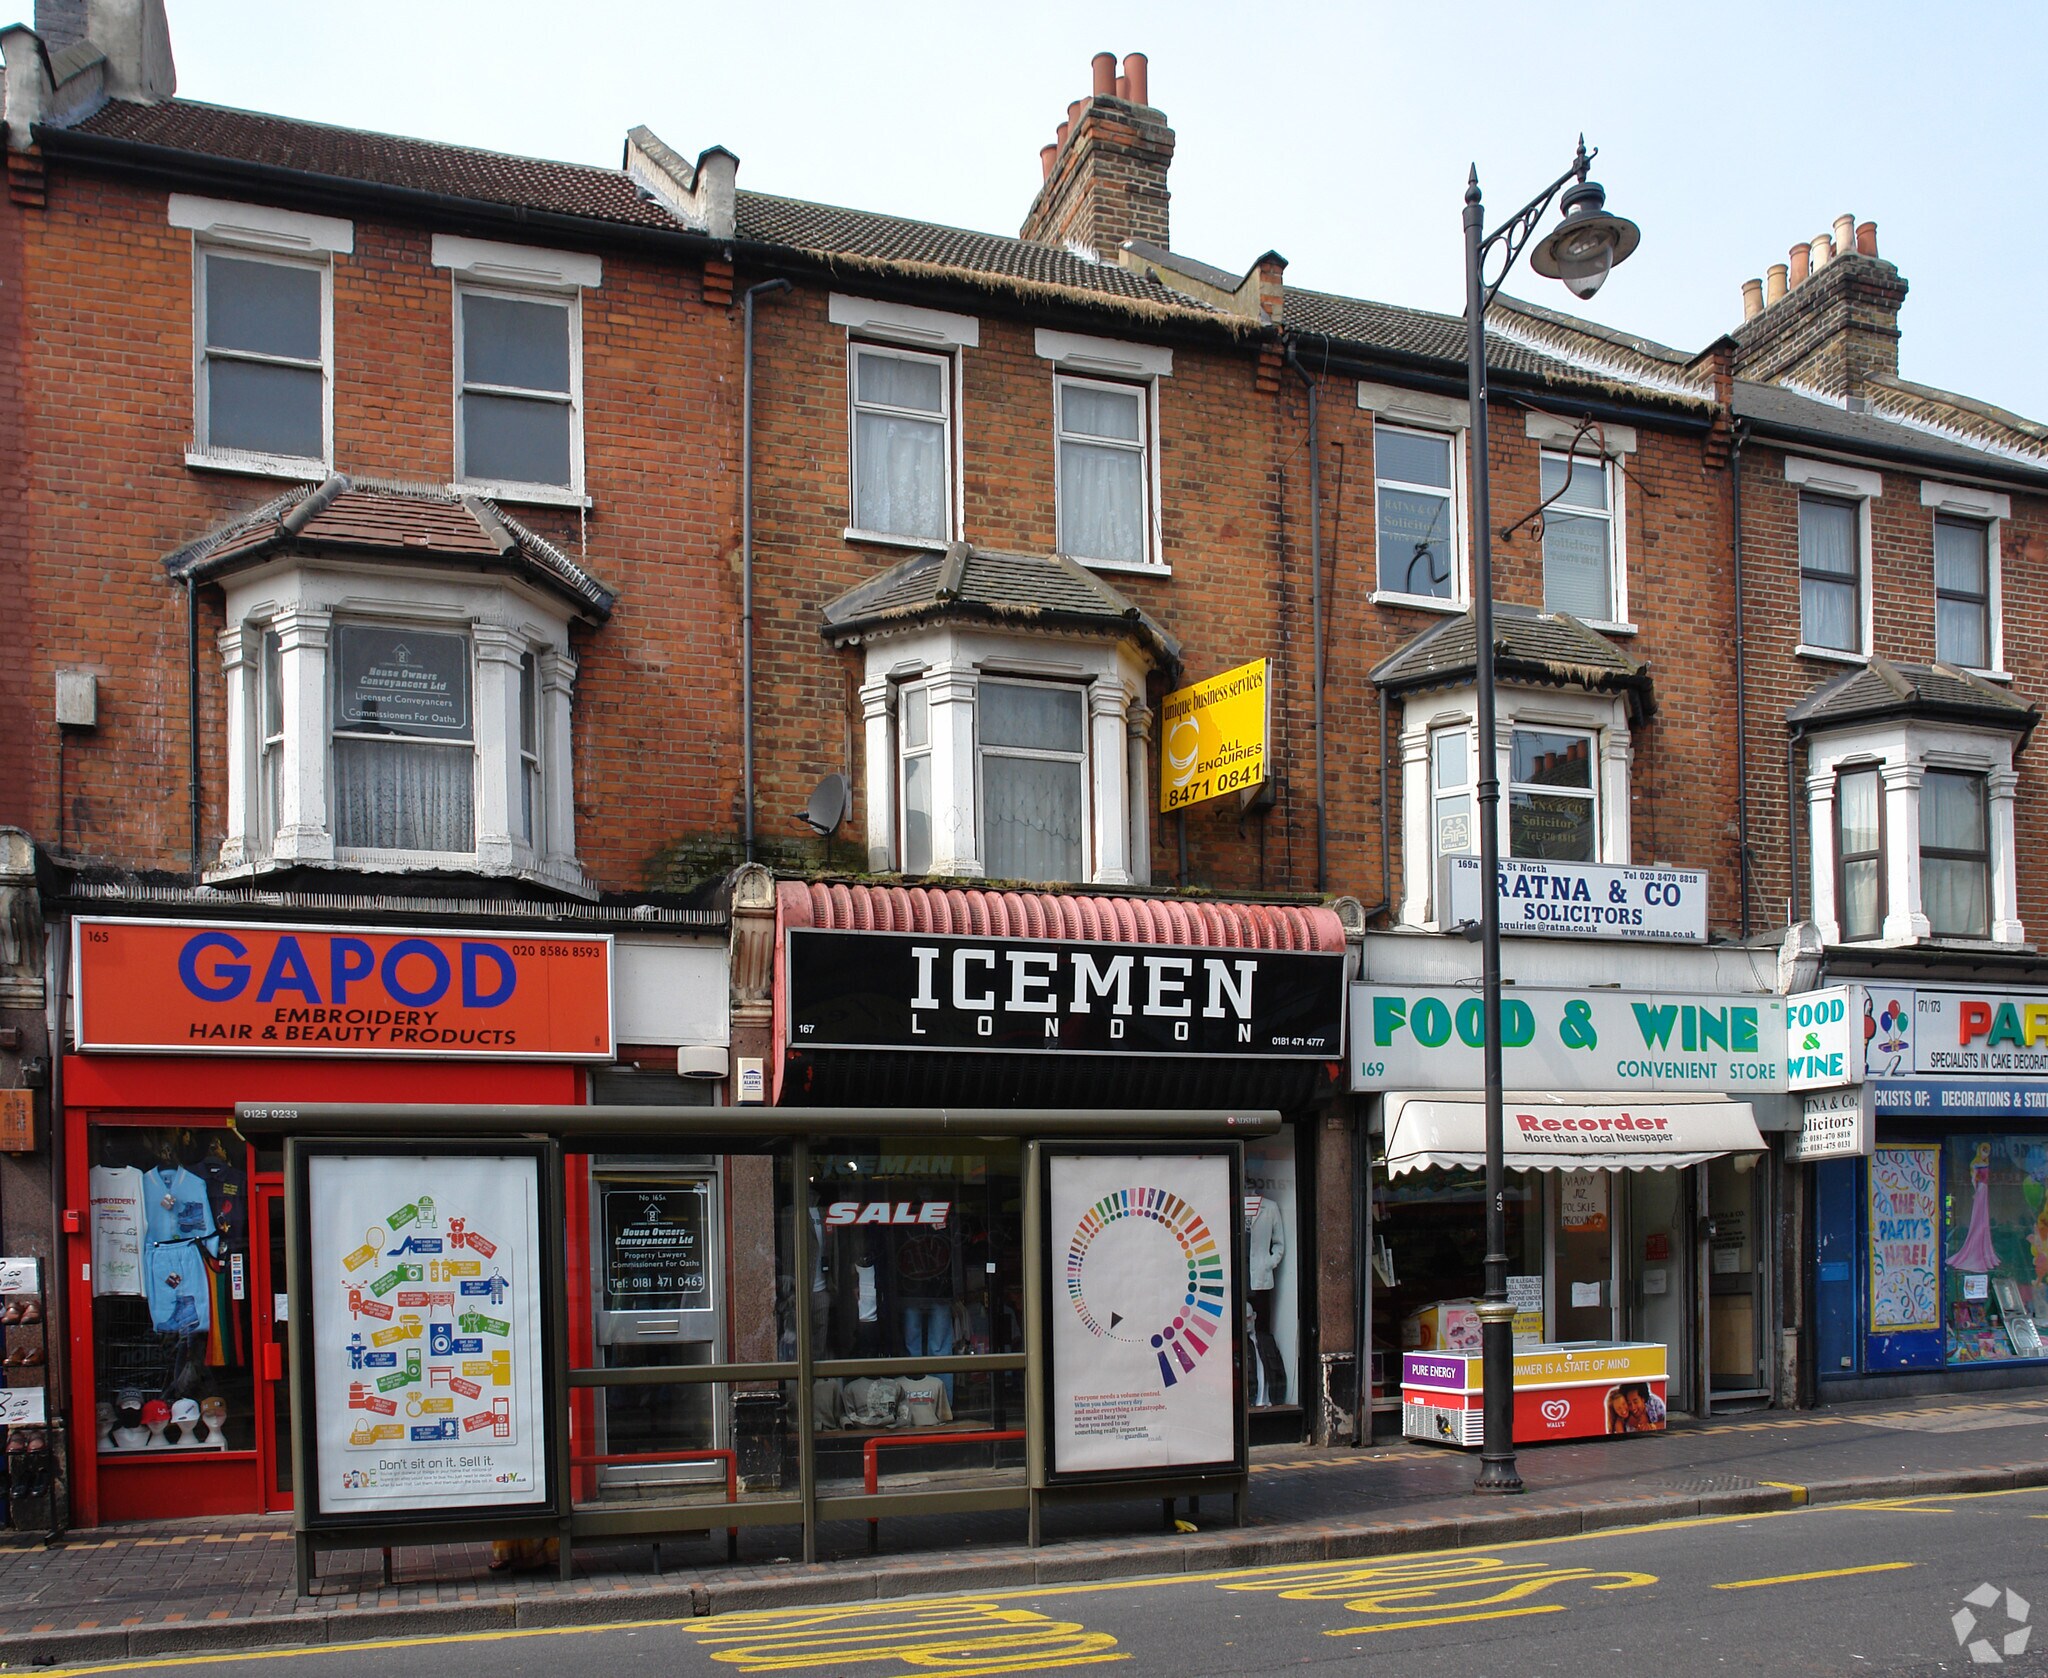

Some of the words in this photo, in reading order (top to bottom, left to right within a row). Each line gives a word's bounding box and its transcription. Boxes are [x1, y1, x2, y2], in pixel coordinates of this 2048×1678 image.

[369, 667, 399, 677] House
[402, 669, 437, 680] Owners
[360, 676, 428, 690] Conveyancers
[430, 681, 447, 691] Ltd
[355, 692, 392, 703] Licensed
[394, 695, 453, 707] Conveyancers
[1164, 697, 1192, 722] unique
[1193, 684, 1228, 710] business
[1229, 670, 1263, 699] services
[349, 708, 412, 720] Commissioners
[414, 713, 428, 721] For
[431, 714, 457, 723] Oaths
[1218, 739, 1243, 755] ALL
[1197, 743, 1263, 774] ENQUIRIES
[1169, 779, 1210, 807] 8471
[1217, 762, 1261, 792] 0841
[1522, 815, 1578, 828] Solicitors
[1458, 860, 1479, 869] 169a
[1507, 863, 1517, 872] St
[1520, 863, 1547, 873] North
[1623, 871, 1637, 880] Tel
[1639, 872, 1652, 881] 020
[1657, 873, 1677, 883] 8470
[1679, 874, 1698, 884] 8818
[1497, 873, 1592, 902] RATNA
[1608, 879, 1627, 904] &
[1644, 882, 1682, 907] CO
[1523, 903, 1643, 926] SOLICITORS
[88, 931, 109, 943] 165
[1621, 928, 1696, 939] www.ratna.co.uk
[512, 945, 535, 956] 020
[540, 946, 568, 957] 8586
[572, 947, 600, 958] 8593
[178, 931, 517, 1009] GAPOD
[910, 946, 1258, 1019] ICEMEN
[1787, 998, 1845, 1029] FOOD
[1917, 1000, 1942, 1013] 171/173
[273, 1007, 438, 1026] EMBROIDERY
[1373, 996, 1536, 1049] FOOD
[1559, 999, 1598, 1052] &
[1630, 1002, 1759, 1052] WINE
[189, 1023, 253, 1040] HAIR
[261, 1025, 278, 1040] &
[285, 1025, 382, 1042] BEAUTY
[390, 1028, 516, 1045] PRODUCTS
[798, 1024, 815, 1034] 167
[1271, 1036, 1290, 1046] 0181
[1291, 1037, 1305, 1046] 471
[1306, 1037, 1326, 1047] 4777
[1802, 1032, 1821, 1051] &
[1787, 1052, 1844, 1079] WINE
[1930, 1052, 1978, 1068] SPECIALISTS
[1981, 1053, 1989, 1069] IN
[1991, 1053, 2013, 1070] CAKE
[1362, 1062, 1385, 1077] 169
[1617, 1060, 1718, 1080] CONVENIENT
[1730, 1062, 1776, 1080] STORE
[1830, 1096, 1838, 1110] &
[1842, 1094, 1858, 1108] Co.
[1914, 1091, 1931, 1107] OF:
[1941, 1091, 2010, 1108] DECORATIONS
[2013, 1092, 2021, 1108] &
[243, 1109, 267, 1118] 0125
[271, 1109, 298, 1118] 0233
[1515, 1113, 1669, 1132] Recorder
[1803, 1116, 1854, 1132] olicitors
[1523, 1133, 1552, 1143] More
[1554, 1133, 1579, 1144] than
[1590, 1133, 1614, 1143] local
[1616, 1133, 1674, 1144] Newspaper
[1837, 1130, 1851, 1139] 8818
[1837, 1140, 1851, 1148] 0131
[1564, 1175, 1595, 1186] MAMY
[1496, 1192, 1503, 1200] 4
[1890, 1193, 1915, 1214] THE
[825, 1201, 950, 1225] SALE
[1496, 1202, 1503, 1211] 3
[1563, 1202, 1596, 1212] POLSKIE
[622, 1228, 650, 1236] House
[652, 1228, 685, 1236] Owners
[1879, 1218, 1931, 1241] PARTY'S
[615, 1237, 677, 1246] Conveyancers
[679, 1236, 694, 1244] Ltd
[1884, 1244, 1926, 1266] HERE!
[612, 1261, 663, 1269] Commissioners
[610, 1278, 629, 1288] Tel:
[632, 1278, 652, 1288] 0181
[657, 1275, 672, 1287] 471
[677, 1277, 703, 1287] 0463
[1412, 1364, 1429, 1376] PURE
[1430, 1366, 1456, 1379] ENERGY
[1546, 1363, 1553, 1373] IS
[1556, 1362, 1562, 1373] A
[1564, 1360, 1590, 1372] STATE
[1593, 1359, 1604, 1371] OF
[1607, 1358, 1629, 1369] MIND
[1101, 1406, 1130, 1414] everything
[1074, 1428, 1103, 1436] something
[379, 1459, 407, 1471] Don't
[411, 1458, 426, 1469] sit
[428, 1459, 443, 1469] on
[446, 1457, 456, 1468] it.
[459, 1457, 480, 1467] Sell
[483, 1455, 494, 1466] it.
